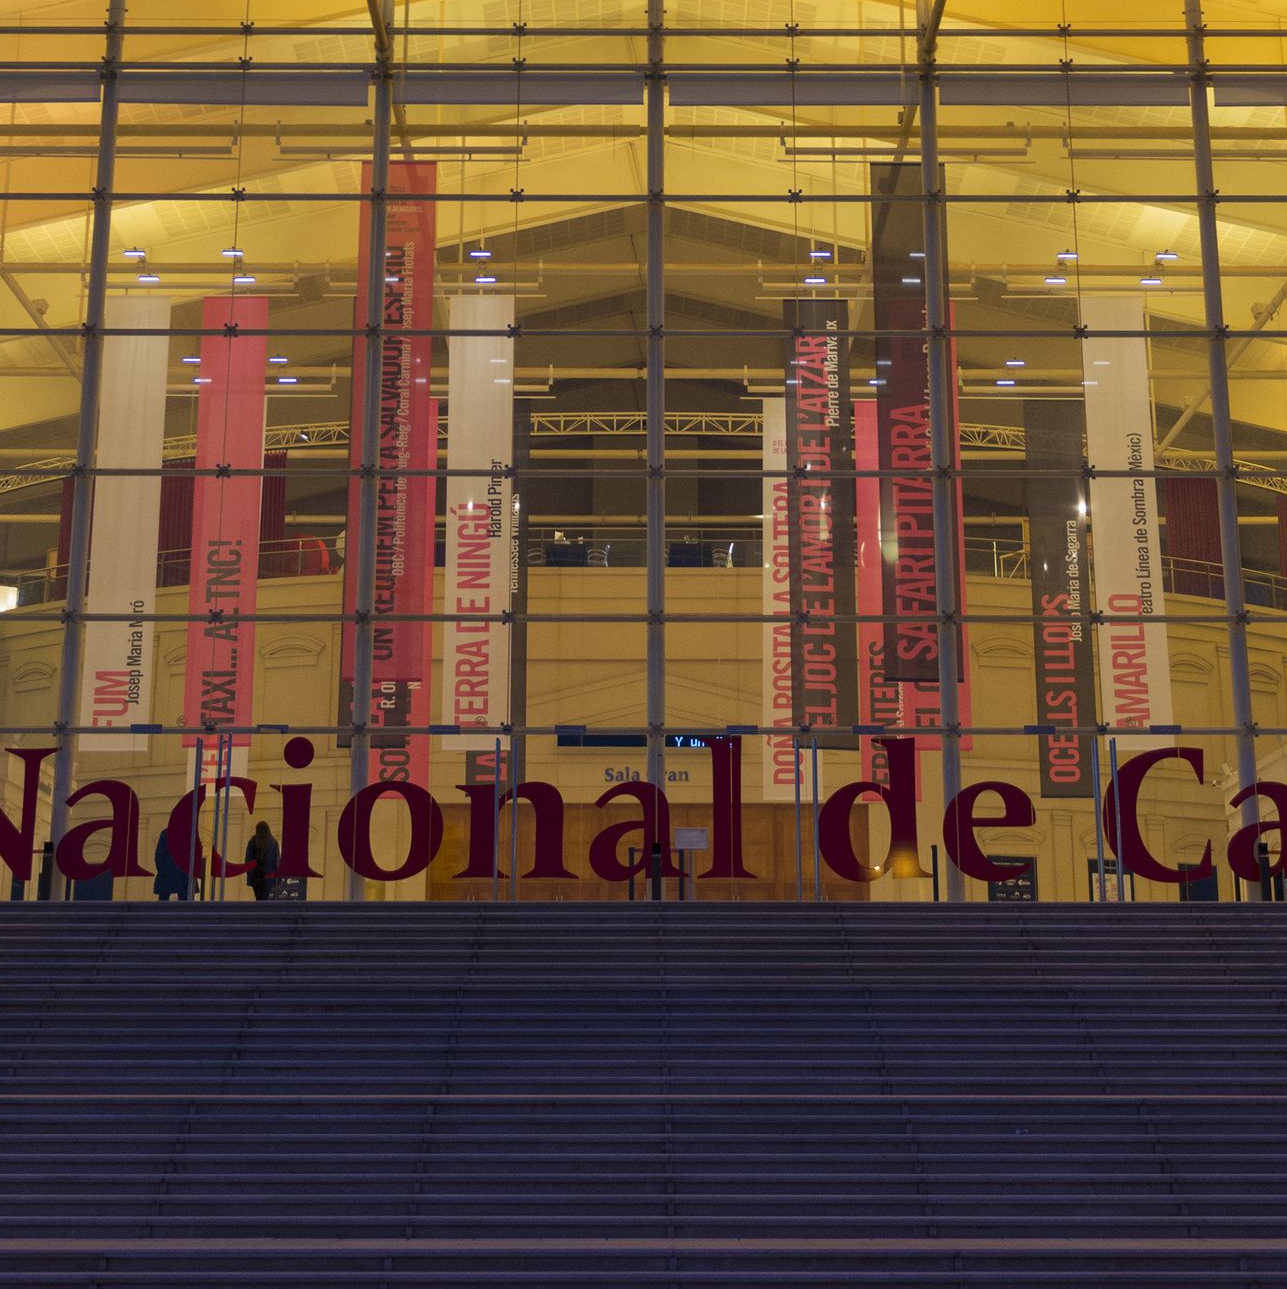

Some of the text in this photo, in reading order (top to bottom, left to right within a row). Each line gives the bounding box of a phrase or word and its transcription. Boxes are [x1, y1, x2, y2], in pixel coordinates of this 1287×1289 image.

[402, 242, 415, 275] Flotats
[401, 278, 414, 305] Maria
[401, 308, 415, 330] osep
[397, 344, 411, 386] Càrmina
[824, 375, 839, 389] de
[397, 389, 410, 415] Coral
[824, 397, 840, 427] Pierre
[396, 425, 410, 469] uig-Reig
[797, 437, 831, 471] DE
[396, 478, 407, 491] de
[487, 459, 503, 539] Harold Piner
[1131, 478, 1147, 526] Sombra
[889, 403, 938, 661] SAFARI PITARRA
[1063, 520, 1080, 563] Sagarra
[1133, 528, 1148, 543] de
[205, 540, 243, 603] TNC!
[391, 555, 405, 576] OBC
[1064, 563, 1079, 577] de
[1136, 546, 1151, 579] Línea
[1065, 580, 1081, 610] Maria
[1139, 582, 1154, 614] eatro
[450, 502, 492, 728] TERRA DE NINGÚ
[803, 599, 835, 635] DE
[125, 600, 145, 705] Josep Maria Mró
[803, 642, 837, 694] JOC
[804, 698, 838, 728] EL
[604, 767, 641, 782] Sala
[819, 737, 1037, 882] de
